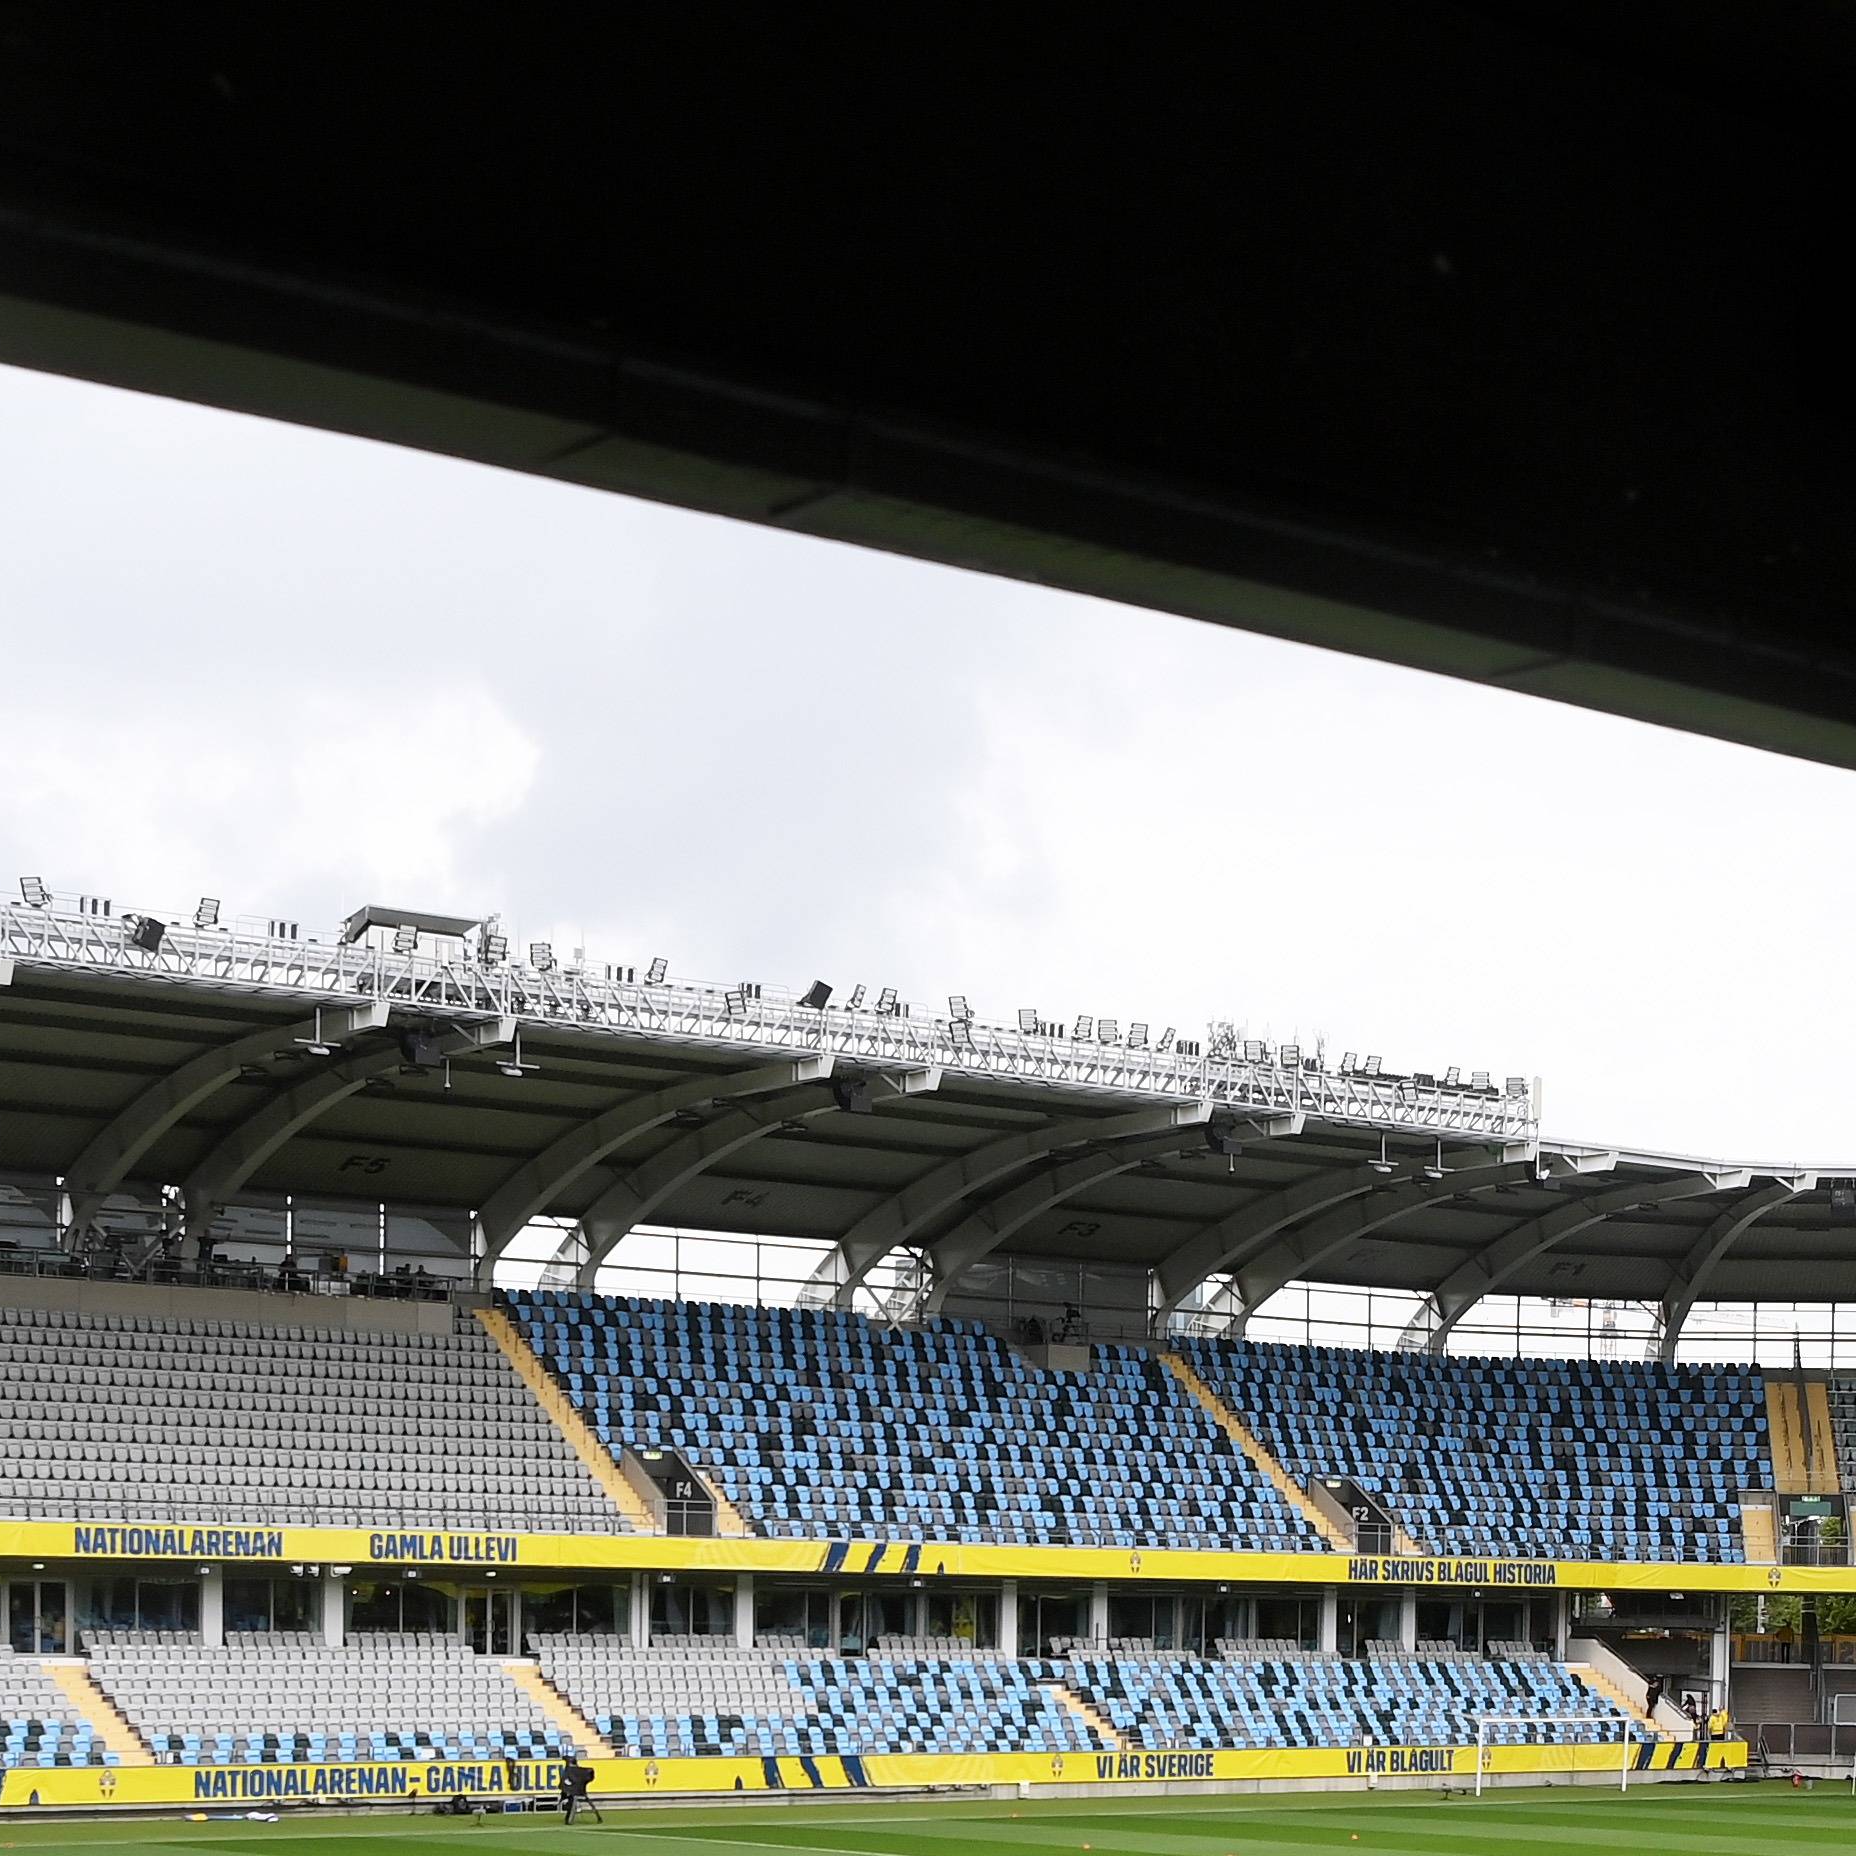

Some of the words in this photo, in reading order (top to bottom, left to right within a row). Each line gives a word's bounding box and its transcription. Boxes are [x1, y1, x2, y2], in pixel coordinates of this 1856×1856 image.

[676, 1481, 693, 1498] F4
[1352, 1506, 1369, 1521] F2
[75, 1527, 283, 1557] NATIONALARENAN
[369, 1534, 444, 1560] GAMLA
[448, 1536, 517, 1562] ULLEVI
[1348, 1558, 1378, 1581] HÄR
[1381, 1560, 1434, 1583] SKRIVS
[1437, 1561, 1490, 1584] BLÅGUL
[1493, 1563, 1556, 1585] HISTORIA
[1096, 1755, 1113, 1779] VI
[1117, 1753, 1141, 1778] ÄR
[1145, 1753, 1215, 1778] SVERIGE
[1346, 1750, 1362, 1774] VI
[1365, 1748, 1387, 1773] ÄR
[1390, 1748, 1455, 1773] BLÅGULT
[427, 1765, 503, 1793] GAMLA
